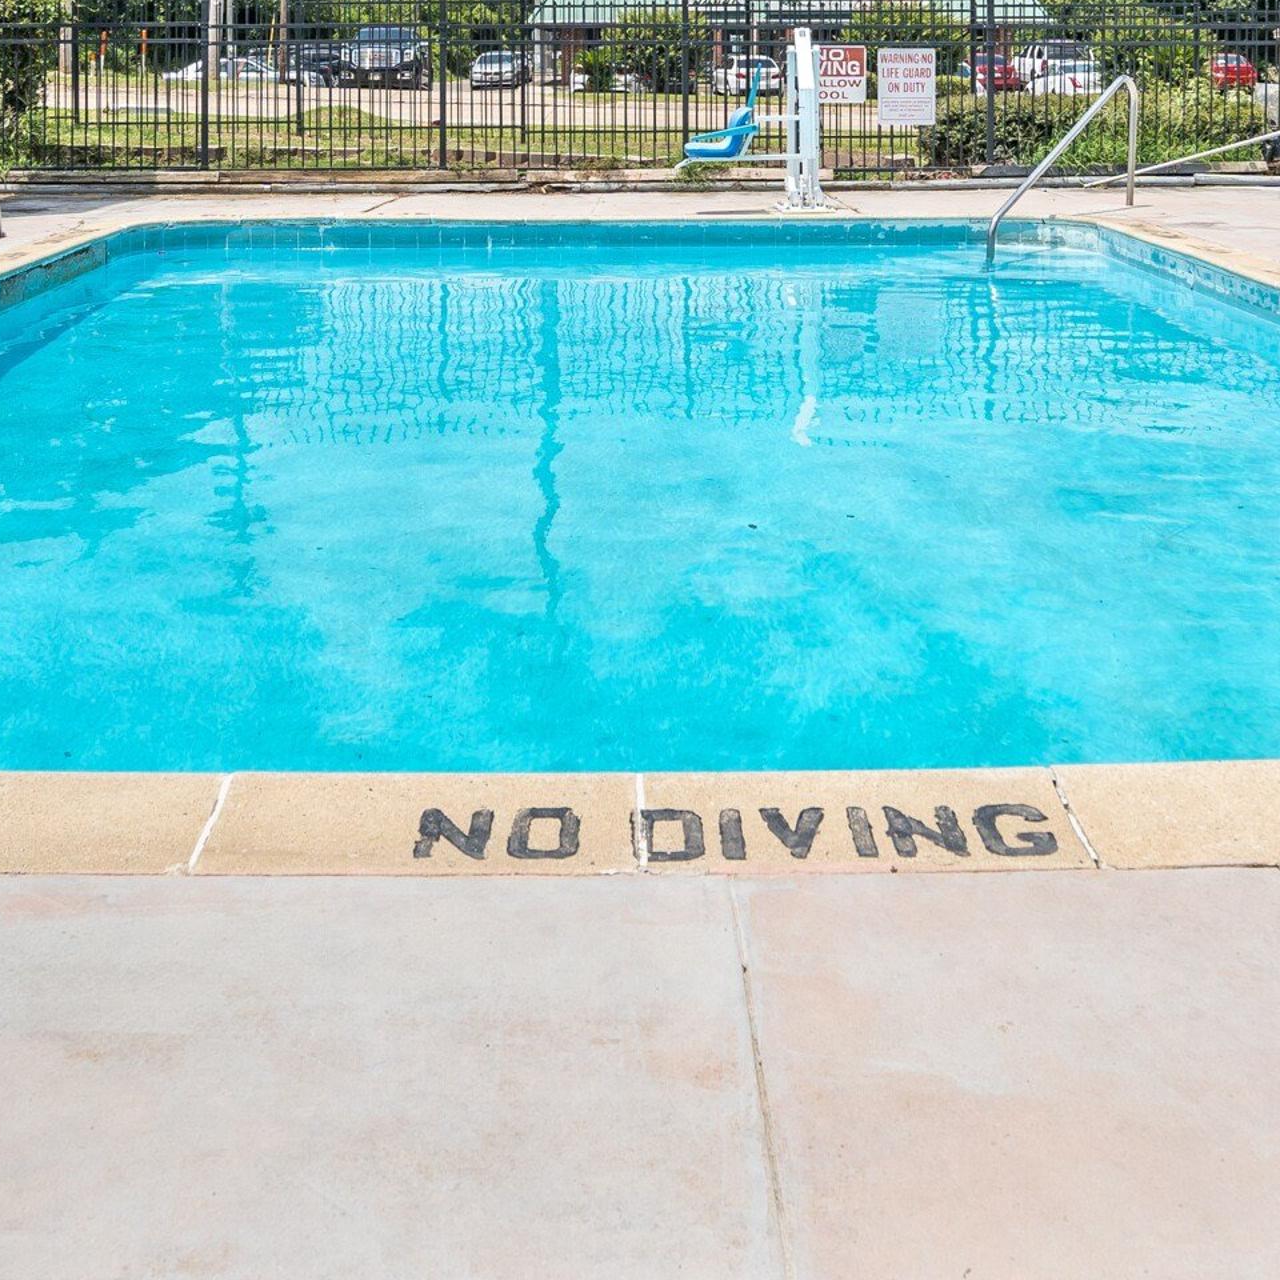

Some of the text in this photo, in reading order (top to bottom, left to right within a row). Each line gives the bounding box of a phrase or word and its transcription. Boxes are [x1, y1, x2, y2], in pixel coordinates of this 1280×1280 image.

[880, 53, 919, 64] WARNING
[820, 60, 861, 76] VING
[882, 67, 931, 78] LIFE GUARD
[887, 82, 925, 93] ON DUTY
[819, 90, 848, 100] OOL
[413, 803, 1058, 862] NO DIVING
